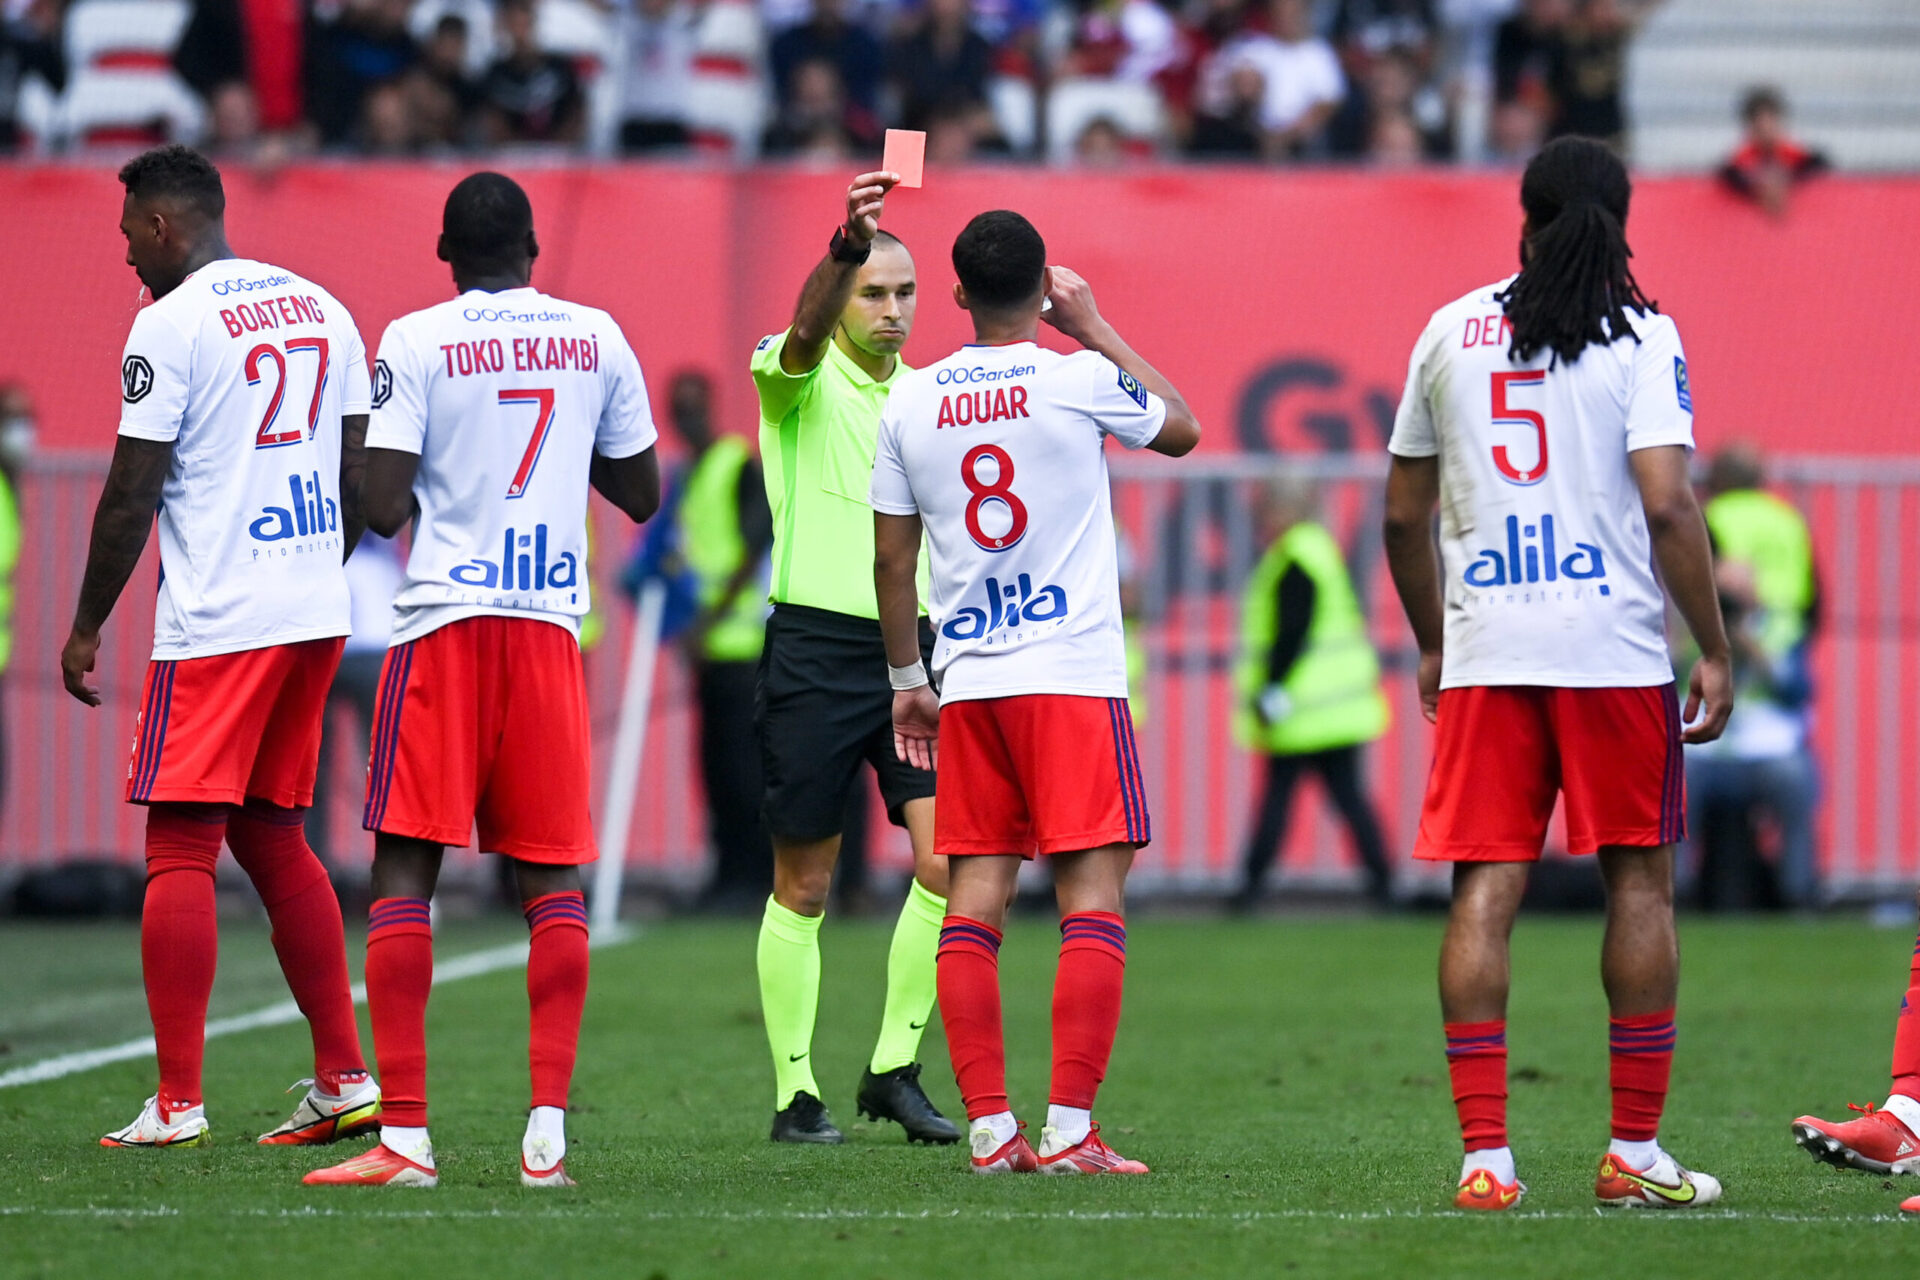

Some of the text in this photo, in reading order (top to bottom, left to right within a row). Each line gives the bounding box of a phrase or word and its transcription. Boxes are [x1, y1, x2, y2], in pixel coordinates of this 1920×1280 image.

[219, 295, 325, 339] BOATENG
[463, 308, 572, 322] OOGarden
[439, 338, 504, 378] TOKO
[936, 364, 1036, 385] OOGarden
[244, 337, 330, 450] 27
[937, 385, 1030, 430] AOUAR
[1490, 369, 1548, 487] 5
[498, 388, 556, 499] 7
[249, 470, 336, 541] alila
[960, 443, 1029, 553] 8
[449, 524, 577, 591] alila
[1463, 513, 1606, 587] alila
[942, 572, 1068, 641] alila
